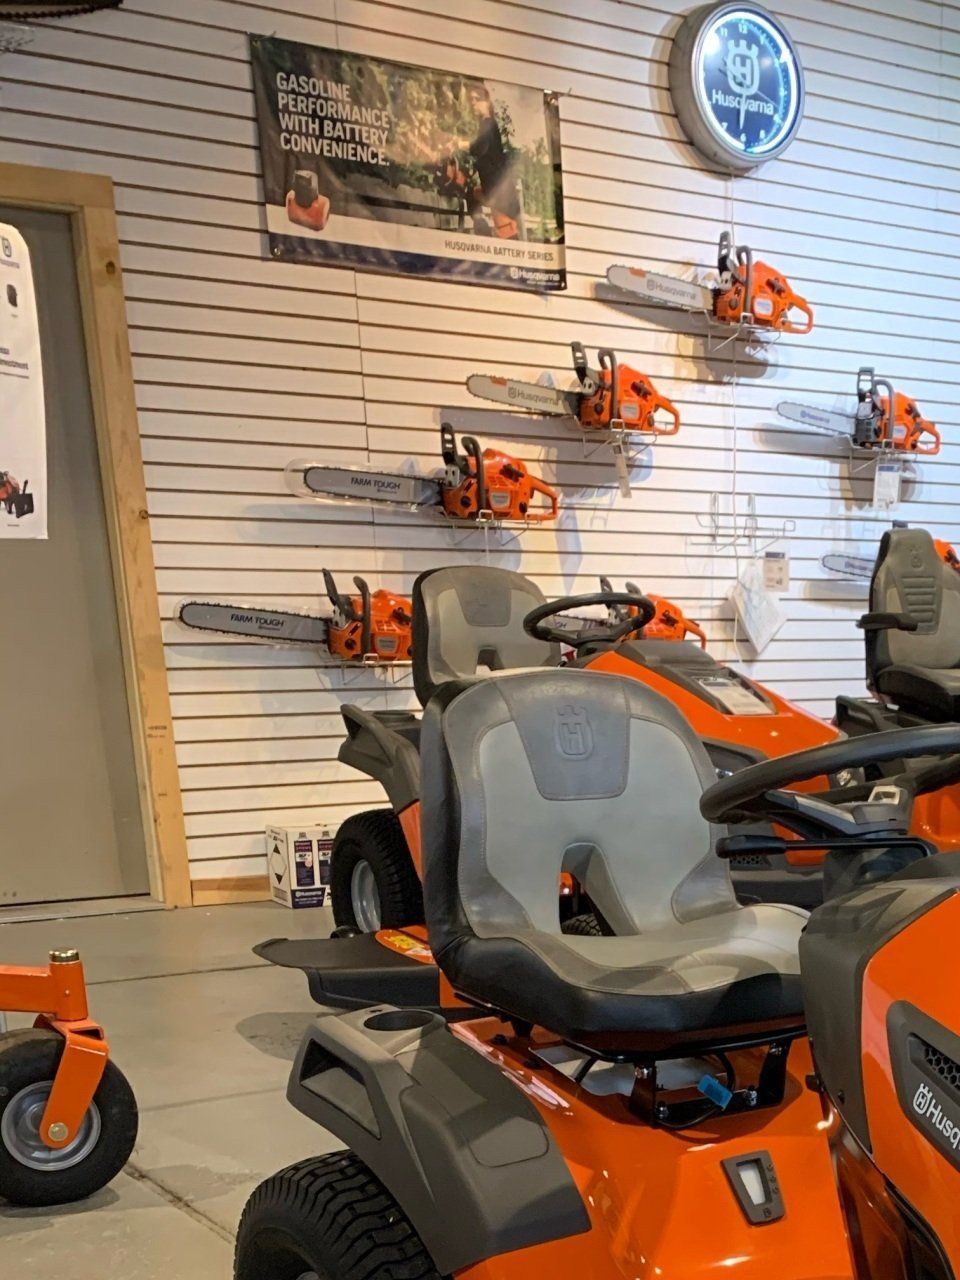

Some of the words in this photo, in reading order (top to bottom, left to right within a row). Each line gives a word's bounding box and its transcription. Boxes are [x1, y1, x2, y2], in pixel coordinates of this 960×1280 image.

[276, 72, 351, 101] GASOLINE
[278, 92, 390, 128] PERFORMANCE
[279, 112, 320, 136] WITH
[323, 120, 388, 147] BATTERY
[280, 132, 390, 166] CONVENIENCE.
[445, 240, 492, 254] HUSQVARNA
[493, 246, 526, 259] BATTERY
[528, 251, 554, 261] SERIES
[351, 476, 372, 487] FARM
[373, 479, 401, 490] TOUGH
[231, 613, 252, 623] FARM
[254, 616, 284, 627] TOUGH
